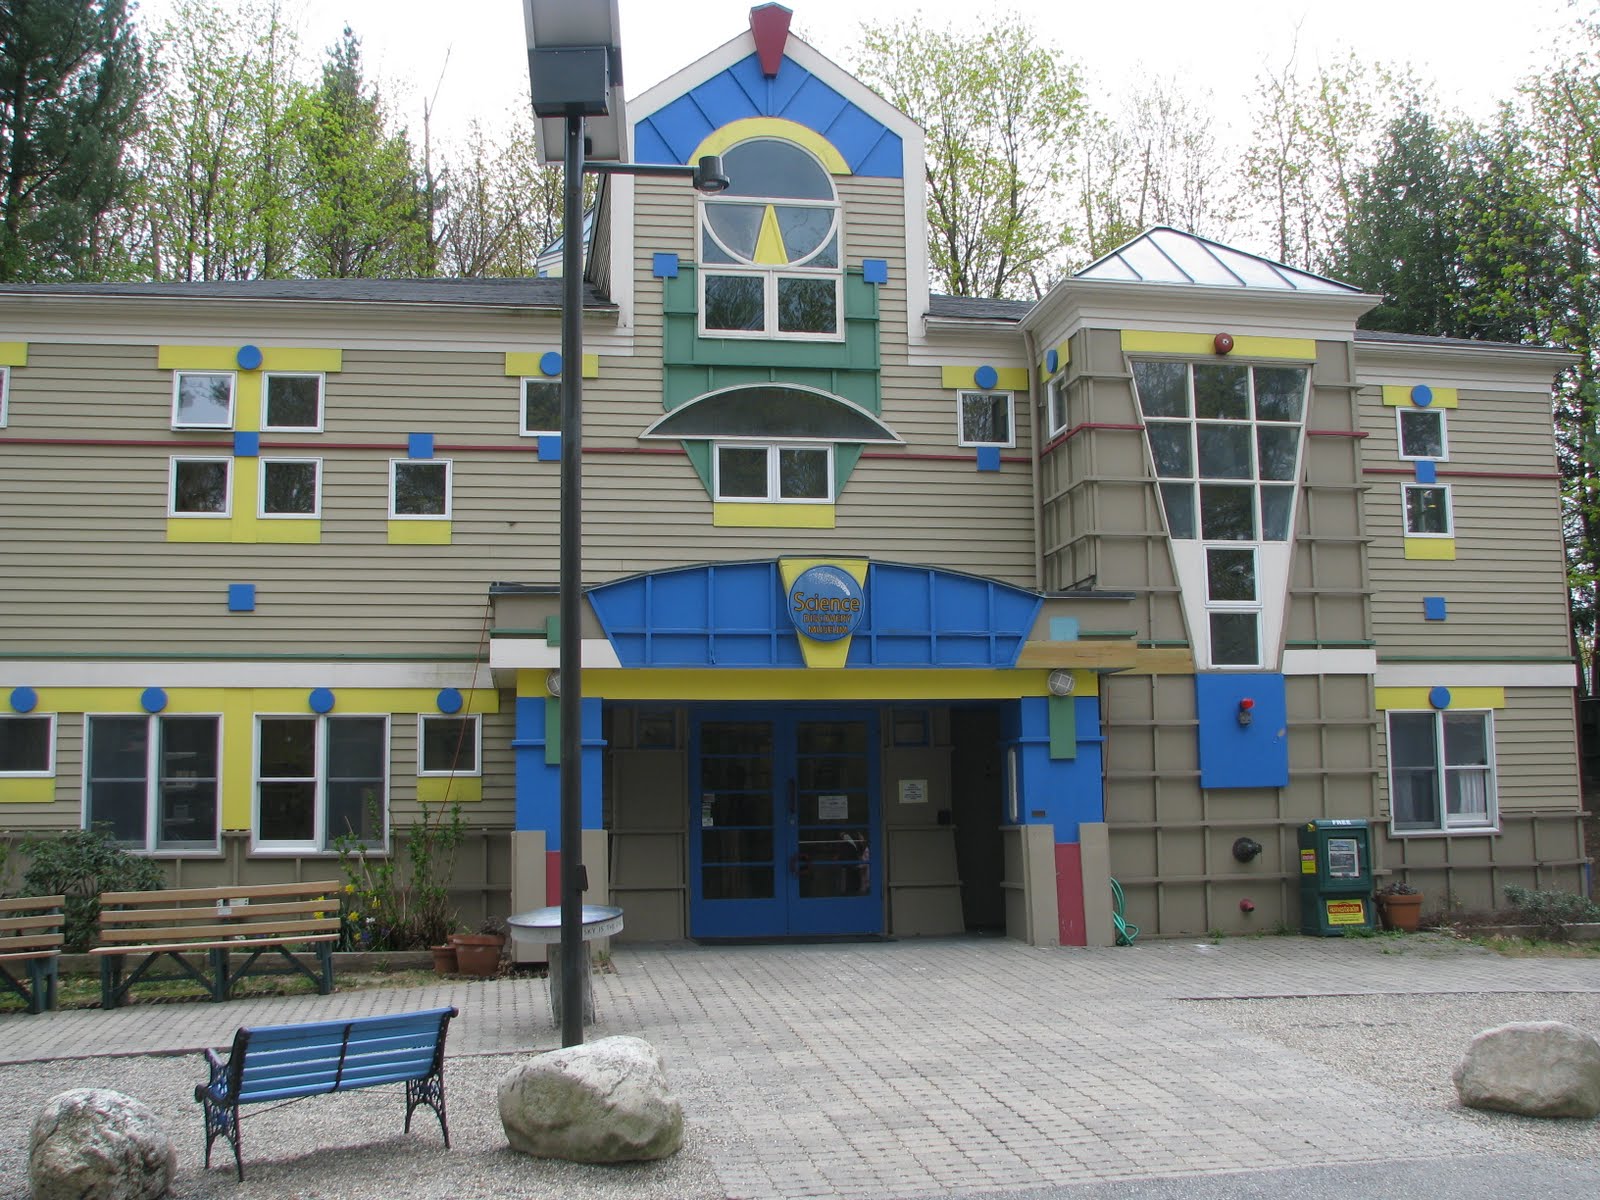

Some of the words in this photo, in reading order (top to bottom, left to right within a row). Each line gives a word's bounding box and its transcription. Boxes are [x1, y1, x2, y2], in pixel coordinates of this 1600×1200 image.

[794, 592, 860, 612] Science
[803, 614, 852, 623] DISCOVERY
[808, 625, 847, 634] MUSEUM
